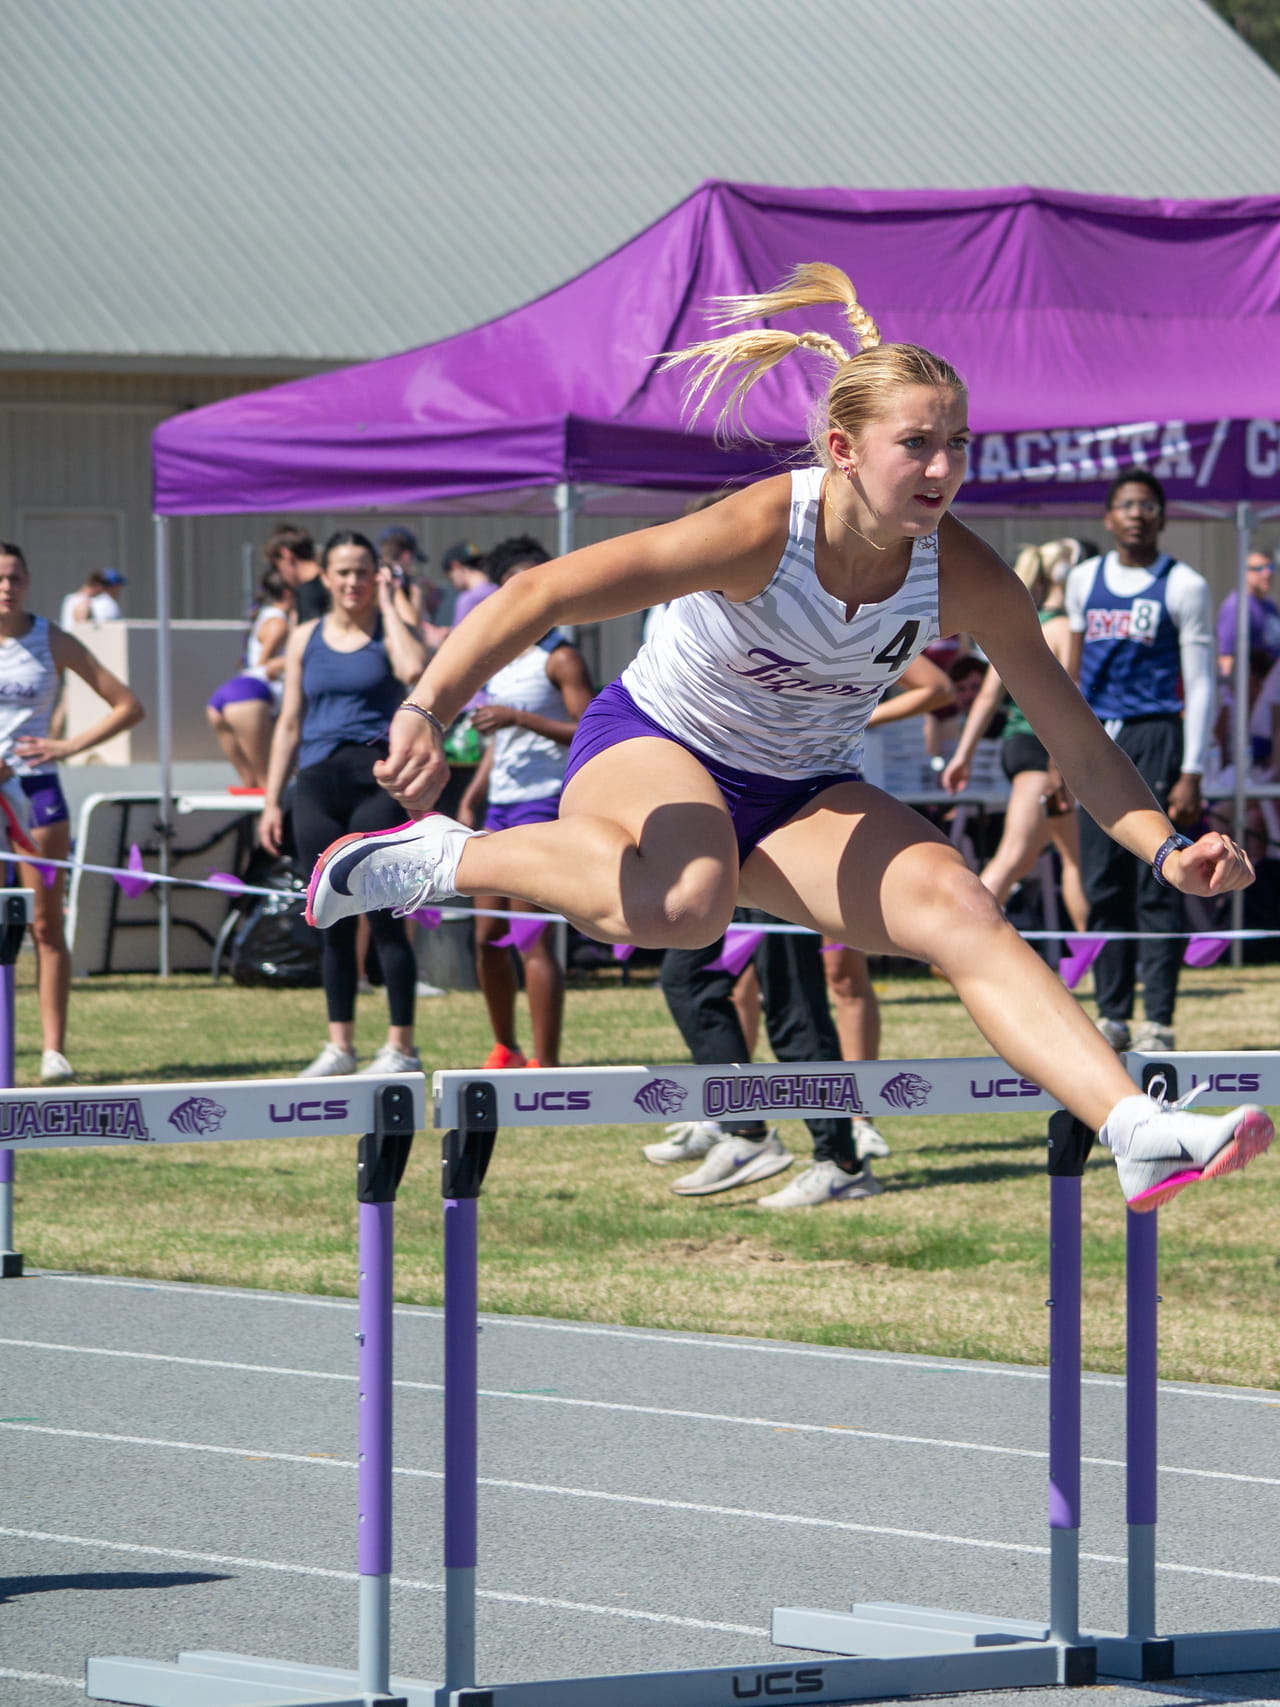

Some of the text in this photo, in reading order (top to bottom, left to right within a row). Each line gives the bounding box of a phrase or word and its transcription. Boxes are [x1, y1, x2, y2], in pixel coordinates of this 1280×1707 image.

[1135, 604, 1153, 632] 8
[872, 619, 921, 673] 4
[514, 1073, 1042, 1117] UCS OUACHITA UCS
[1191, 1073, 1262, 1093] UCS
[0, 1098, 350, 1142] UACHITA UCS
[732, 1668, 825, 1698] UCS
